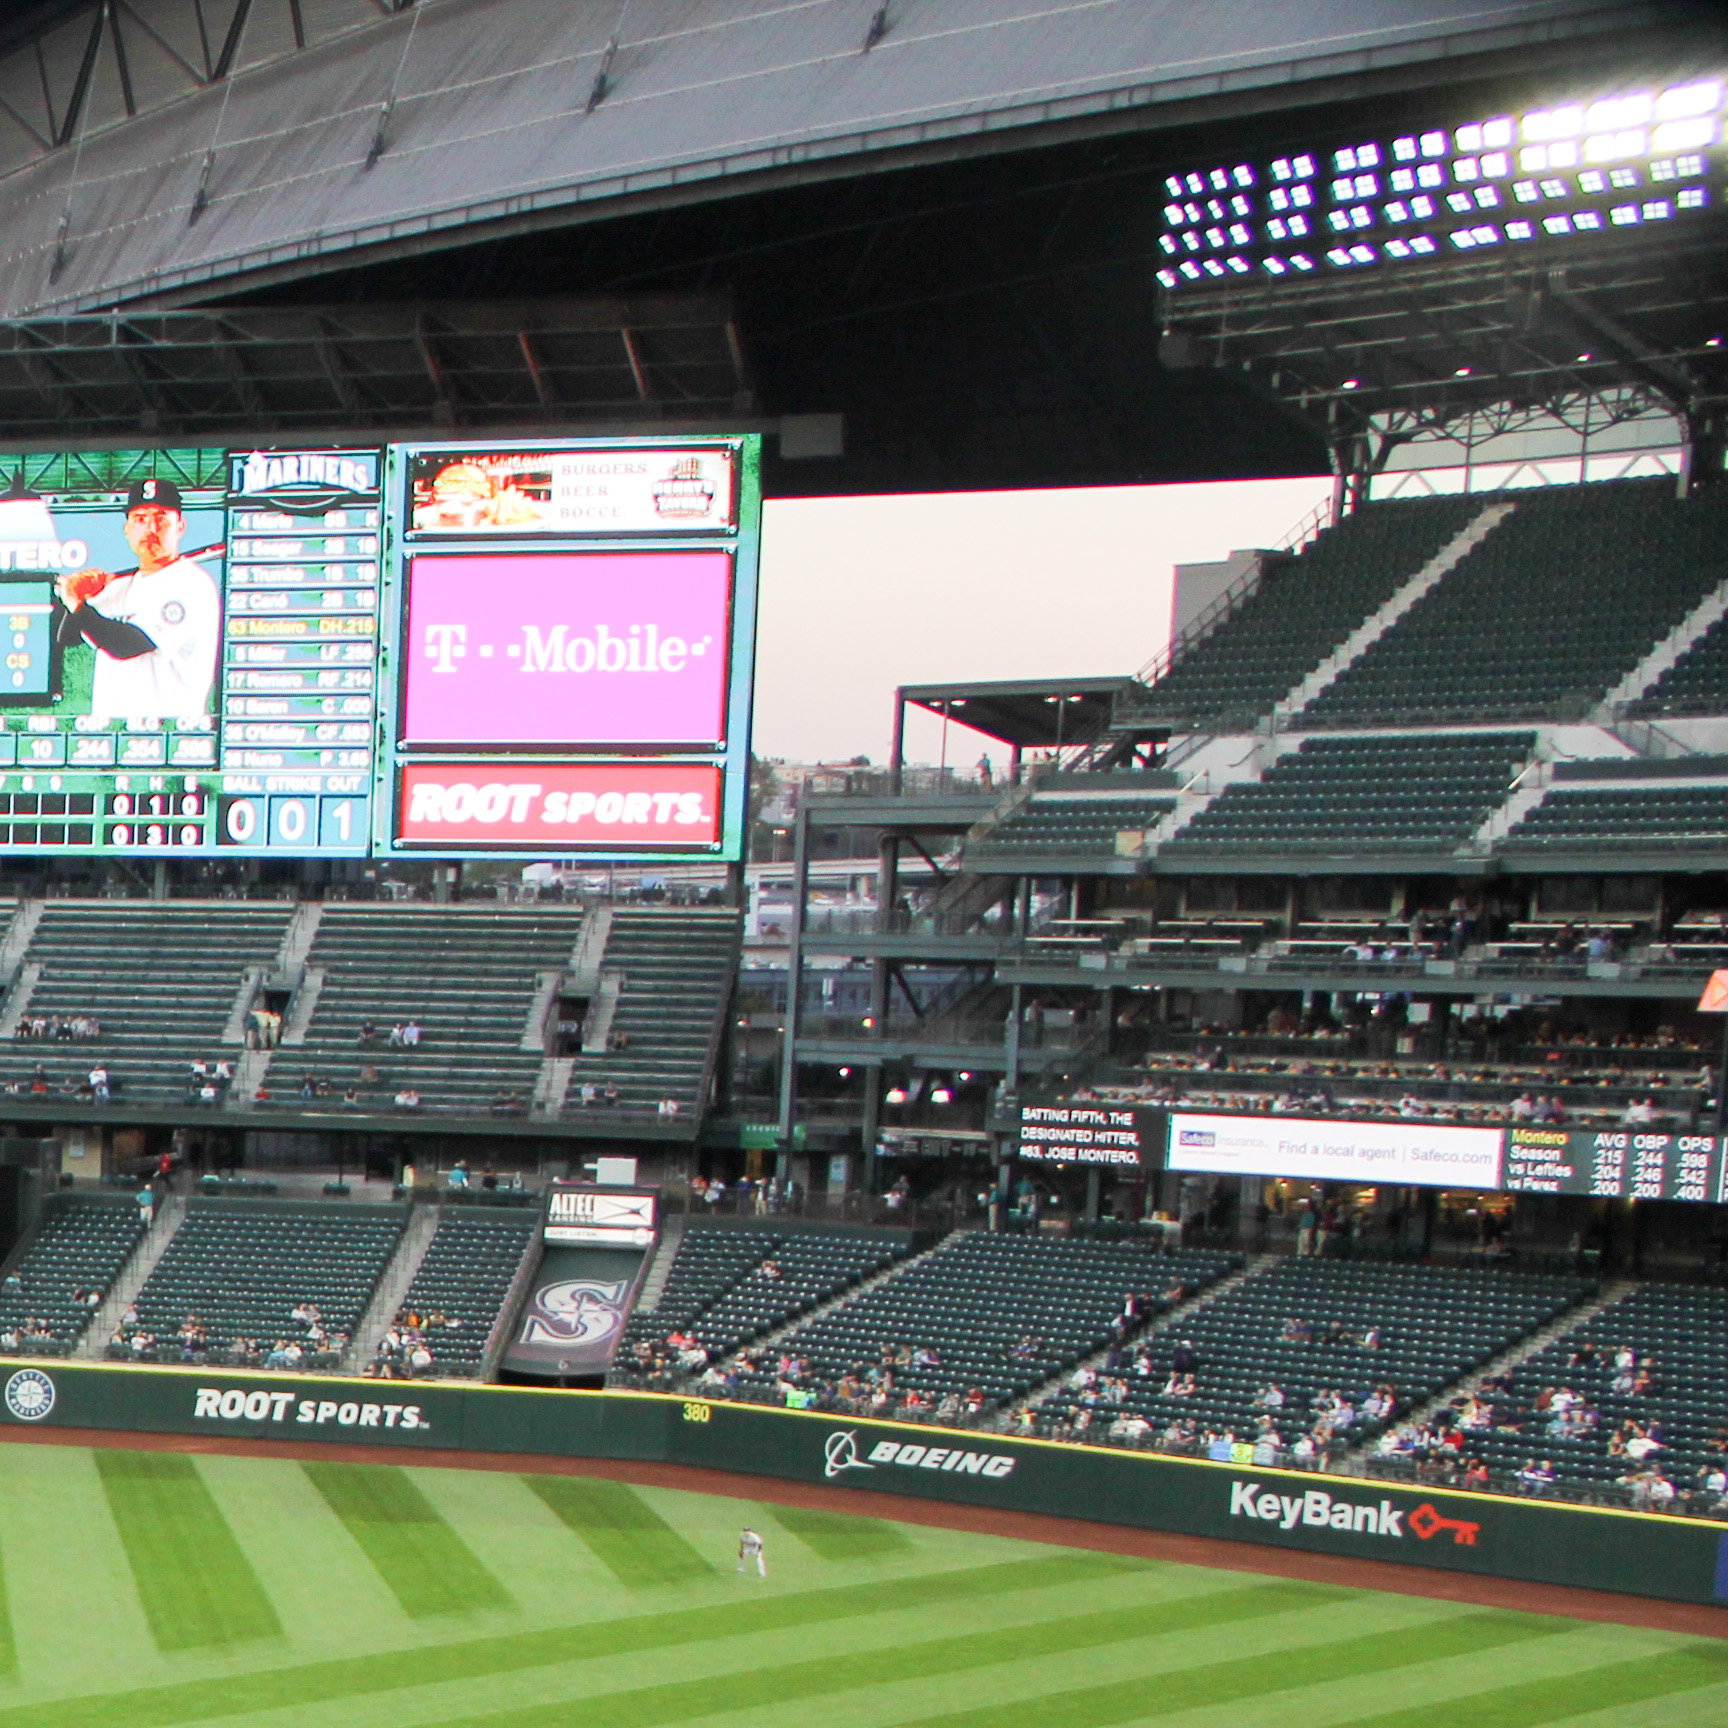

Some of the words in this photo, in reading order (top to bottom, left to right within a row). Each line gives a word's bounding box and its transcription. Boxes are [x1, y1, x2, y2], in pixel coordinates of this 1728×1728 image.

[239, 451, 369, 496] MARINERS
[6, 652, 30, 668] CS
[30, 739, 52, 757] 10
[223, 776, 262, 792] BALL
[266, 776, 323, 792] STRIKE
[327, 775, 362, 791] OUT
[409, 783, 542, 823] ROOT
[226, 799, 256, 842] 0
[278, 799, 306, 842] 0
[331, 799, 353, 841] 1
[1021, 1107, 1069, 1123] BATTING
[1109, 1111, 1134, 1126] THE
[1021, 1126, 1093, 1143] DESIGNATED
[1511, 1129, 1569, 1145] Montero
[1593, 1133, 1628, 1148] AVG
[1633, 1134, 1669, 1150] OBP
[1678, 1136, 1714, 1152] OPS
[1279, 1140, 1308, 1155] Find
[1322, 1142, 1355, 1158] local
[1358, 1145, 1395, 1162] agent
[1411, 1147, 1493, 1165] Safeco.com
[1510, 1145, 1561, 1162] Season
[1592, 1150, 1624, 1164] .215
[1632, 1151, 1664, 1166] .244
[1509, 1163, 1524, 1174] vs
[1527, 1162, 1573, 1178] Lefties
[1591, 1165, 1623, 1180] .204
[1589, 1181, 1621, 1196] .200
[1629, 1182, 1661, 1198] .200
[1673, 1185, 1706, 1200] .400
[194, 1388, 296, 1422] ROOT
[683, 1403, 710, 1423] 380
[869, 1441, 1015, 1479] BOEING
[1231, 1480, 1404, 1539] KeyBank
